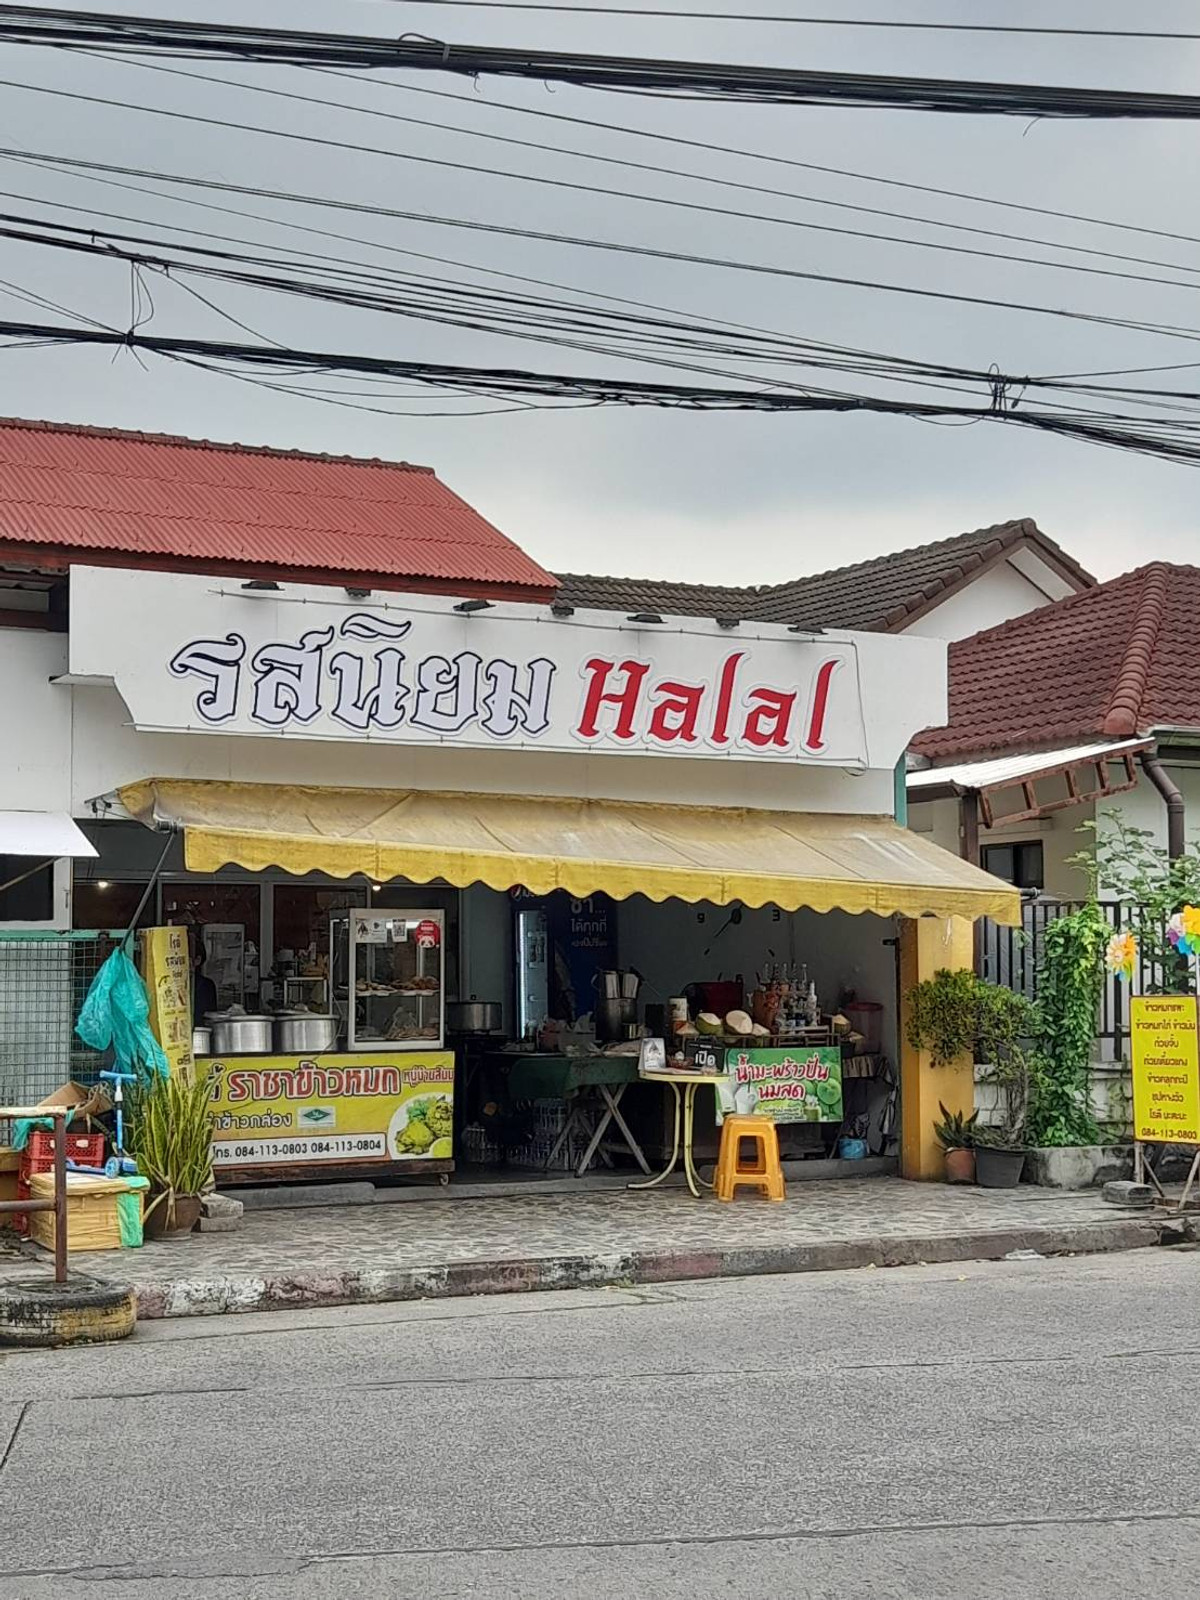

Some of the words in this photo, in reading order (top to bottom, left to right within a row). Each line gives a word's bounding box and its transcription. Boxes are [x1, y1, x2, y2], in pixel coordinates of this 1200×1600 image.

[170, 613, 557, 736] รสนิยม
[576, 651, 840, 749] Halal
[697, 912, 705, 923] 9
[772, 909, 780, 922] 3
[1135, 1017, 1171, 1030] ข้าวหมกไก่
[695, 1050, 716, 1067] เปิด
[735, 1053, 829, 1082] น้ำมะพร้าวปั่น
[229, 1061, 400, 1101] ราชาข้าวหมก
[758, 1082, 805, 1099] นมสด
[235, 1143, 307, 1157] 084-113-0803
[311, 1140, 381, 1153] 084-113-0804
